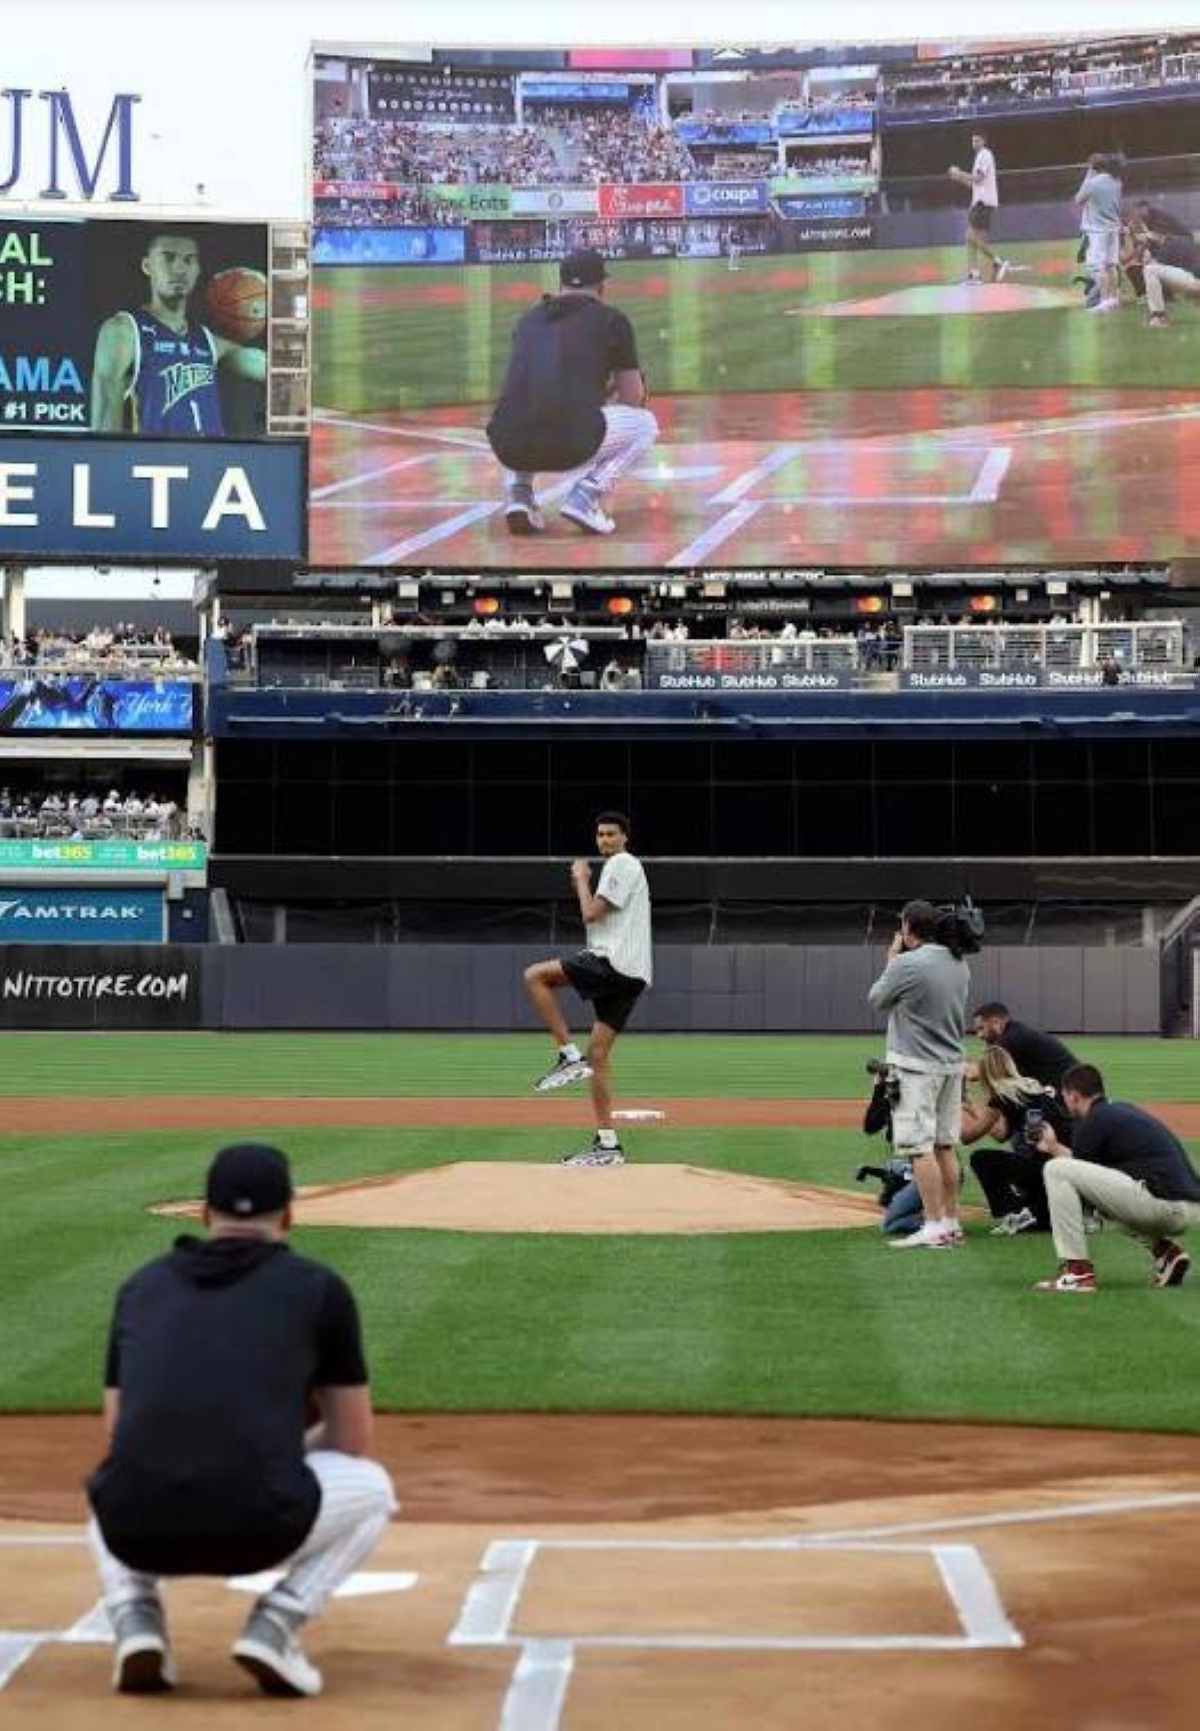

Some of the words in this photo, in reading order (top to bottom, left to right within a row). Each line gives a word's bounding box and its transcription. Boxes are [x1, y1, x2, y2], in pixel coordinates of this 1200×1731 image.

[712, 187, 759, 204] coupa
[0, 233, 53, 266] AL
[0, 271, 45, 304] H:
[5, 402, 27, 419] #1
[35, 403, 85, 420] PICK
[0, 463, 267, 531] ELTA
[660, 674, 715, 688] StubHub
[721, 675, 777, 688] StubHub
[782, 674, 838, 687] StubHub
[910, 673, 966, 686] StubHub
[979, 673, 1036, 686] StubHub
[32, 844, 92, 859] bet365
[137, 846, 196, 861] bet365
[14, 905, 138, 919] AMTRAK
[3, 971, 188, 999] NITTOTIRE.COM
